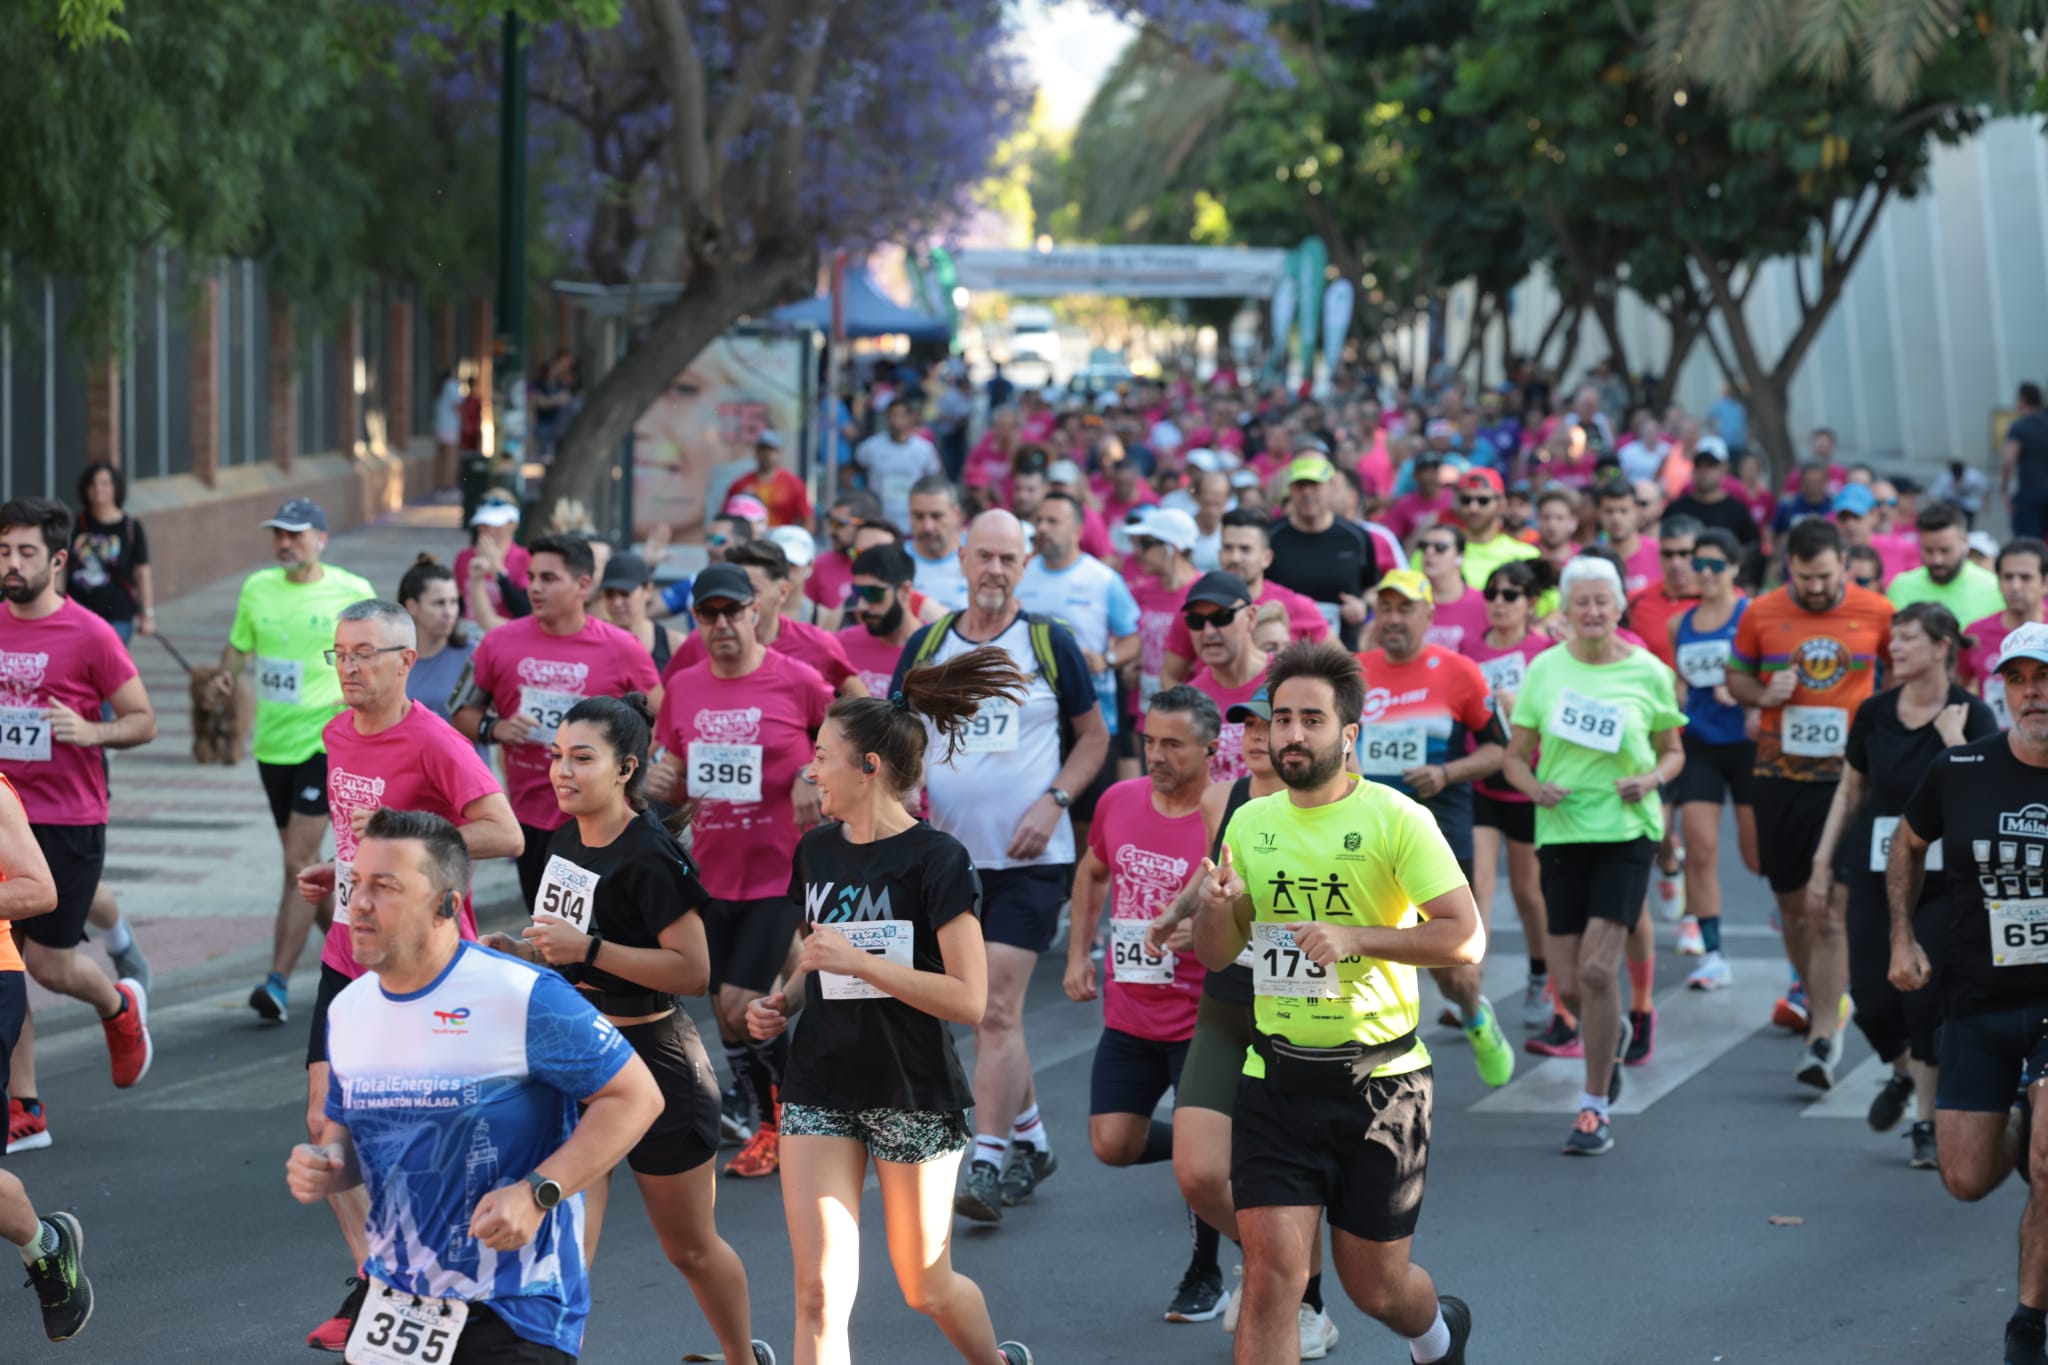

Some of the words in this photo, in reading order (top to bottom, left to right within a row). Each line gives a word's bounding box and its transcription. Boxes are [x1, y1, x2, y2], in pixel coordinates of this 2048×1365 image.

[530, 707, 563, 729] 33
[1562, 706, 1616, 737] 598
[1790, 723, 1840, 743] 220
[1369, 741, 1417, 761] 642
[698, 763, 752, 784] 396
[2007, 817, 2048, 834] Mála
[543, 882, 585, 926] 504
[1263, 948, 1327, 978] 173
[354, 1075, 461, 1097] TotalEnergies
[367, 1096, 412, 1109] MARATÓN
[414, 1094, 460, 1108] MÁLAGA
[366, 1311, 450, 1364] 355
